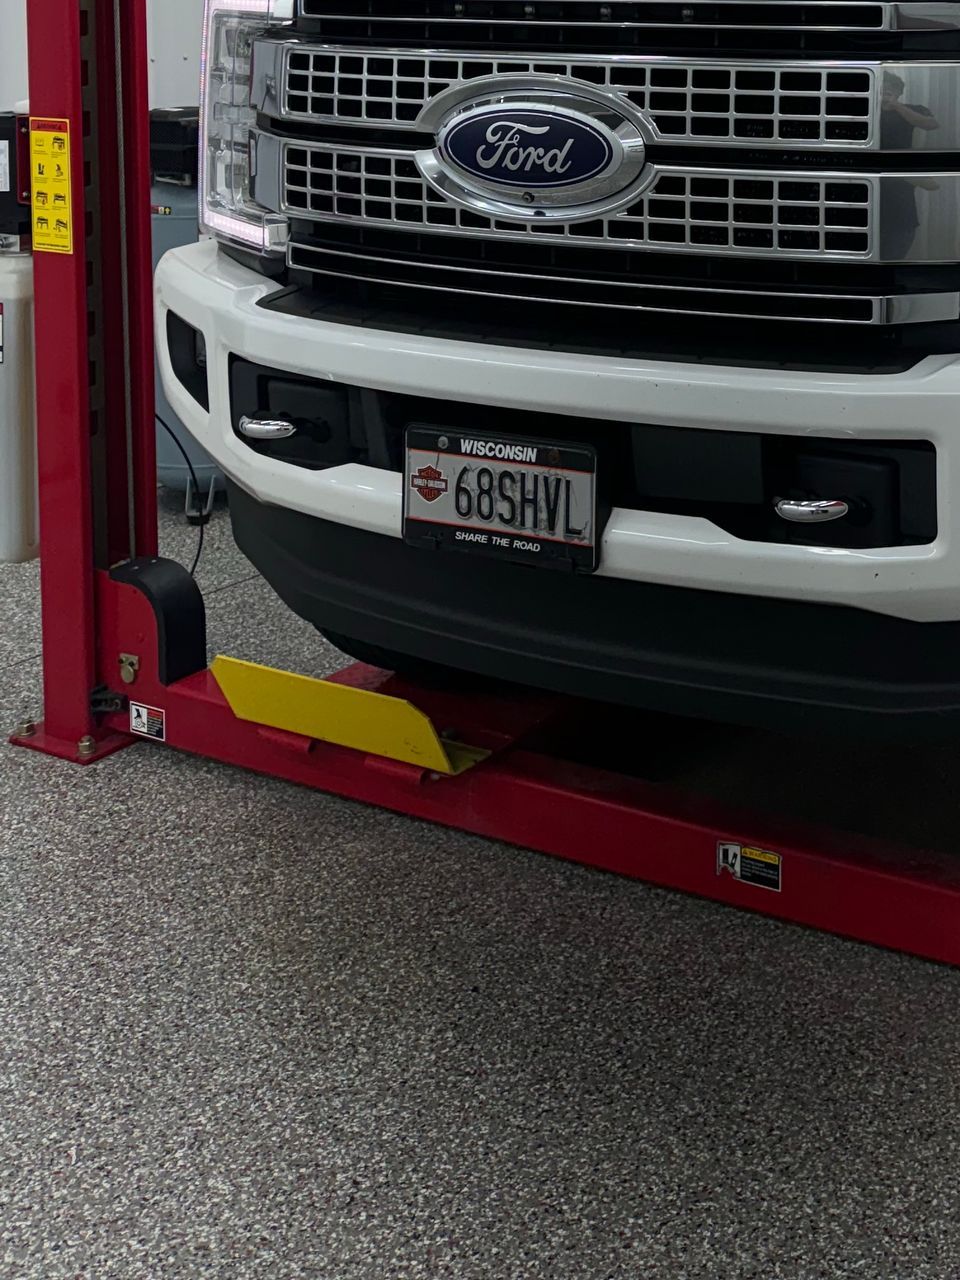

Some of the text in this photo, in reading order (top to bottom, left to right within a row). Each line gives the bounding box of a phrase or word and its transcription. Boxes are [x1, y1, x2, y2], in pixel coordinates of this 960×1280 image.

[475, 121, 574, 173] Ford
[460, 439, 537, 462] WISCONSIN
[455, 466, 582, 535] 68SHVL
[455, 531, 541, 552] SHARE THE ROAD
